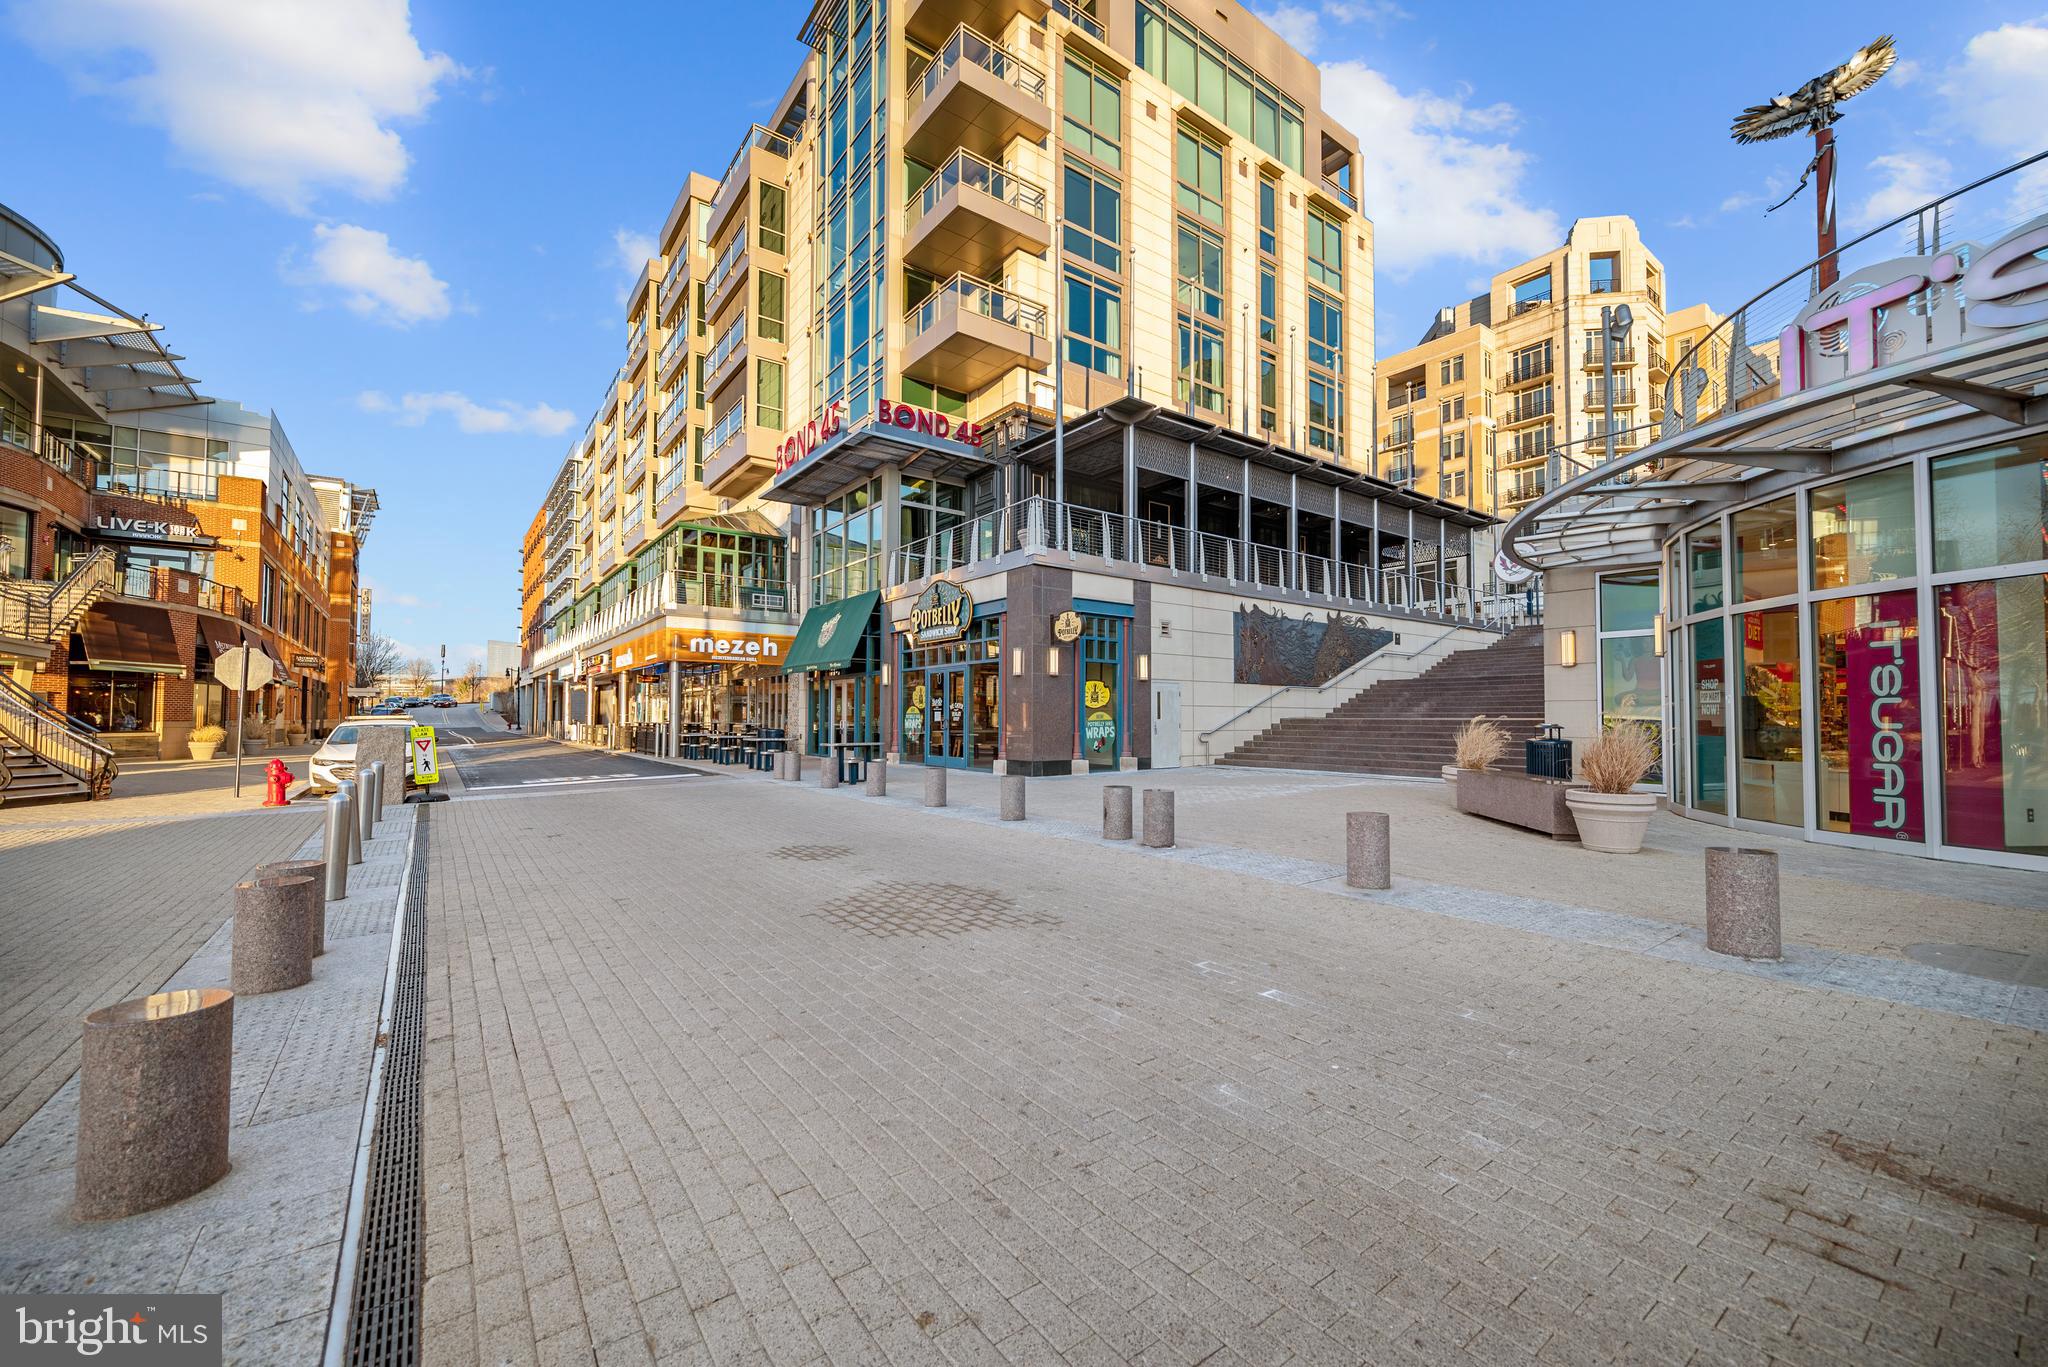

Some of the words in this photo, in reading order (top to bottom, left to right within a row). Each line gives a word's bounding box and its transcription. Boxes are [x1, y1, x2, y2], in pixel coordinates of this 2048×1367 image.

[878, 399, 950, 439] BOND
[953, 421, 984, 448] 45
[776, 419, 817, 477] BOND
[820, 399, 846, 443] 45
[96, 515, 168, 535] LIVE-K
[911, 596, 963, 634] POTBELLY
[920, 627, 944, 639] SANDWICH
[1058, 625, 1079, 637] POTBELLY
[1747, 623, 1761, 641] DIET
[690, 637, 778, 657] mezeh
[1701, 679, 1719, 690] SHOP
[1701, 704, 1720, 716] NOW!
[1085, 726, 1116, 739] WRAPS
[1869, 620, 1906, 830] IT'SUGAR
